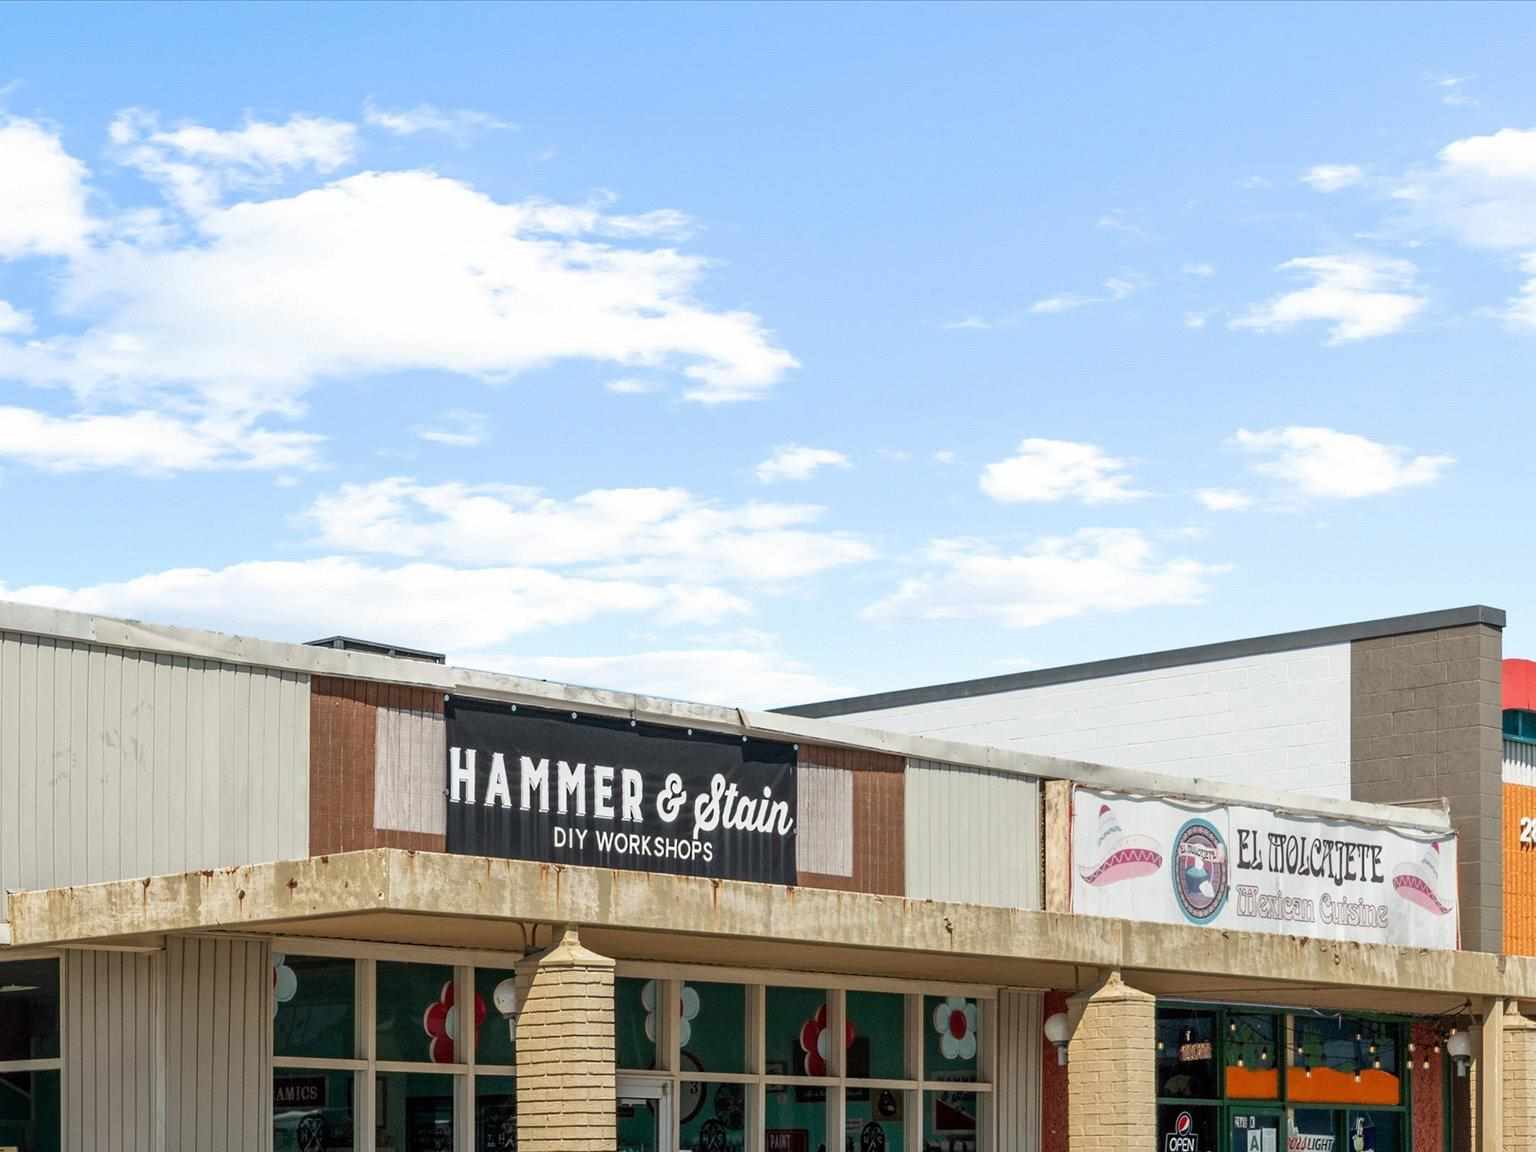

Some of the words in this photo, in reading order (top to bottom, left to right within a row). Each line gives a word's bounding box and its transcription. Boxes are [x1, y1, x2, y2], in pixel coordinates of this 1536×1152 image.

[449, 746, 644, 823] HAMMER
[656, 773, 687, 823] &
[693, 773, 793, 840] Stain
[554, 826, 588, 850] DIY
[595, 830, 713, 862] WORKSHOPS
[1237, 829, 1263, 871] EL
[1267, 832, 1384, 886] MOLCAJETE
[1236, 884, 1315, 923] Mexican
[1320, 892, 1388, 928] Cuisine
[275, 1086, 319, 1102] AMICS
[1169, 1137, 1195, 1152] OPEN
[1250, 1135, 1260, 1152] A
[1306, 1137, 1333, 1151] LIGHT
